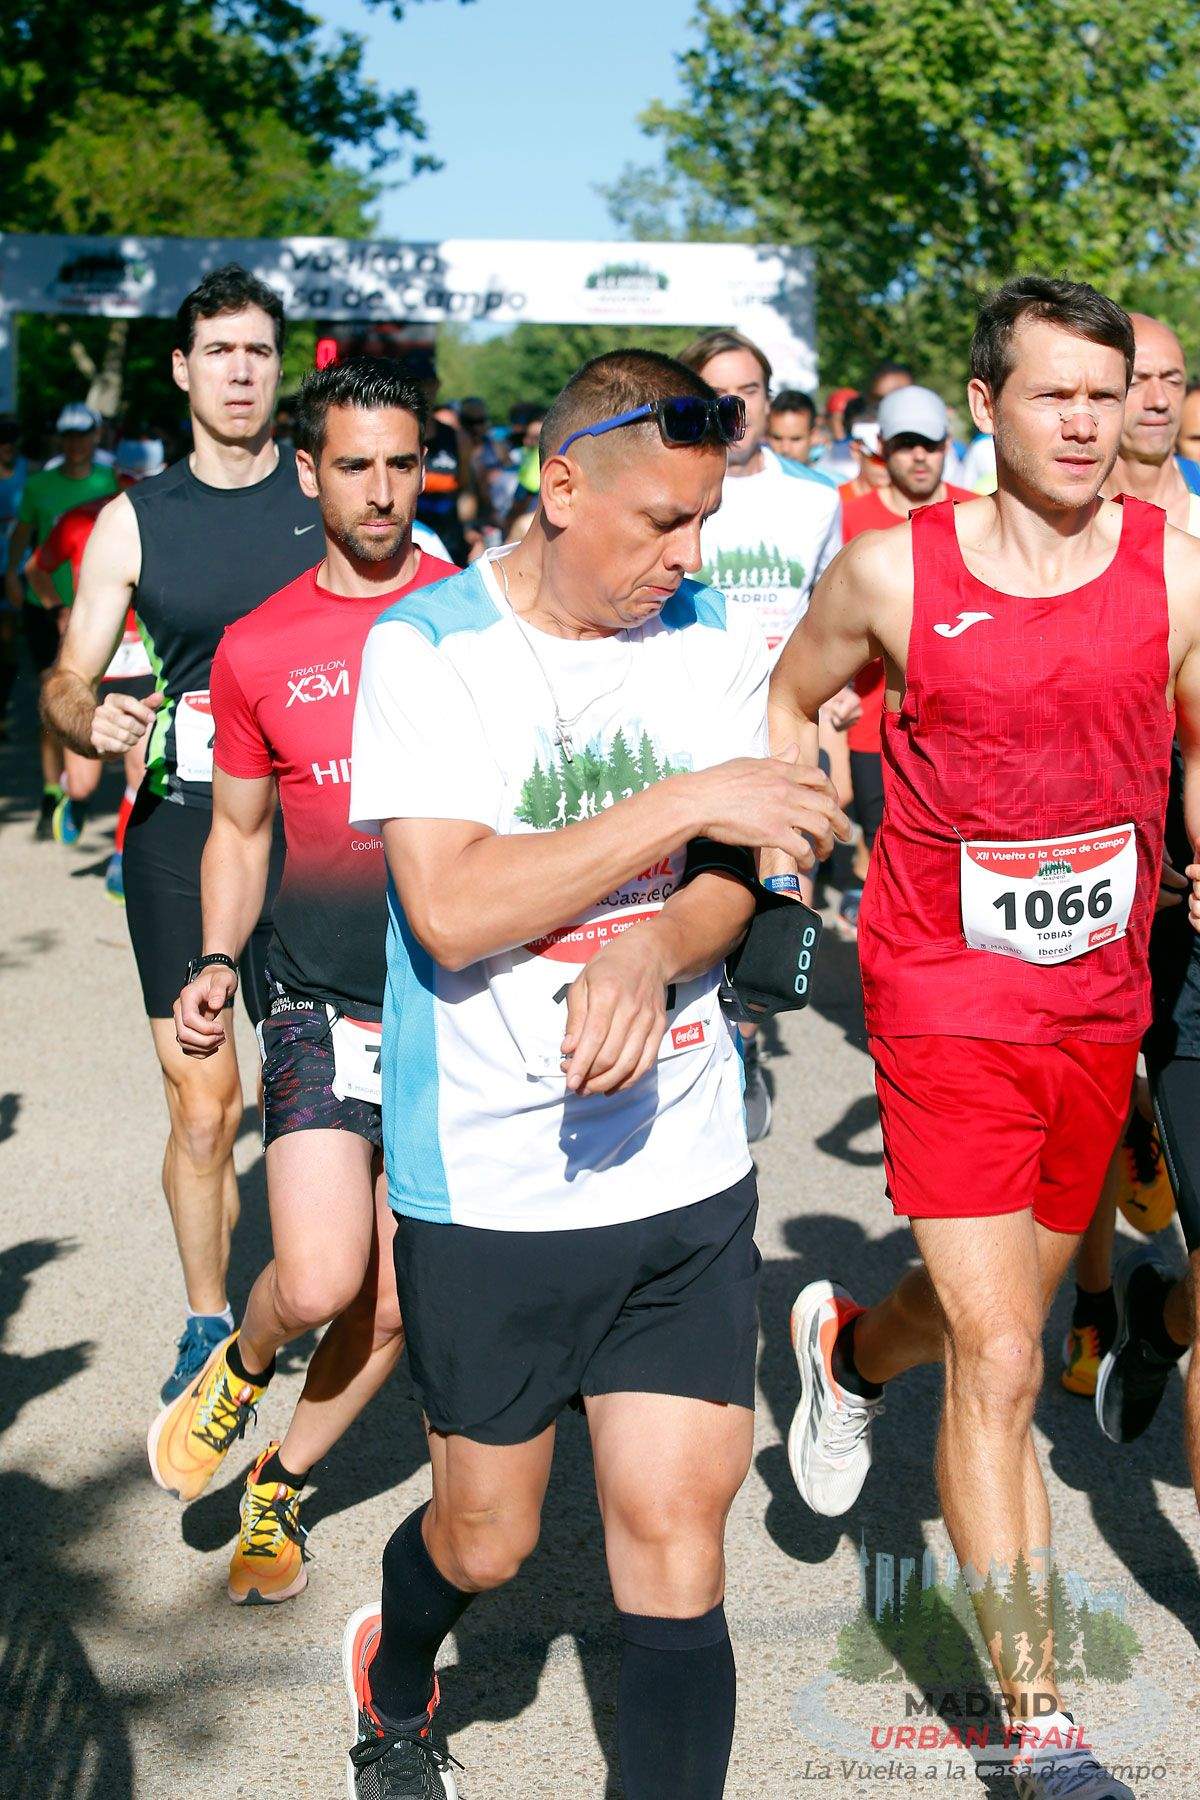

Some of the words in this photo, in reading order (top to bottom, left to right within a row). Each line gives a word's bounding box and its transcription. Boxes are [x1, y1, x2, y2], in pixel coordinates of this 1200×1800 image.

[401, 283, 527, 318] Campo
[727, 594, 777, 603] ADRID
[288, 659, 346, 679] TRIATLON
[311, 758, 351, 785] HI
[976, 851, 989, 860] XII
[992, 850, 1026, 860] Vuelta
[1037, 850, 1048, 859] la
[1052, 848, 1077, 858] Casa
[1079, 843, 1091, 853] de
[1093, 837, 1125, 850] Campo
[992, 879, 1112, 930] 1066
[544, 931, 584, 945] Vuelta
[586, 931, 595, 940] a
[597, 926, 608, 937] la
[1037, 930, 1073, 941] TOBIAS
[990, 944, 1022, 955] MADRID
